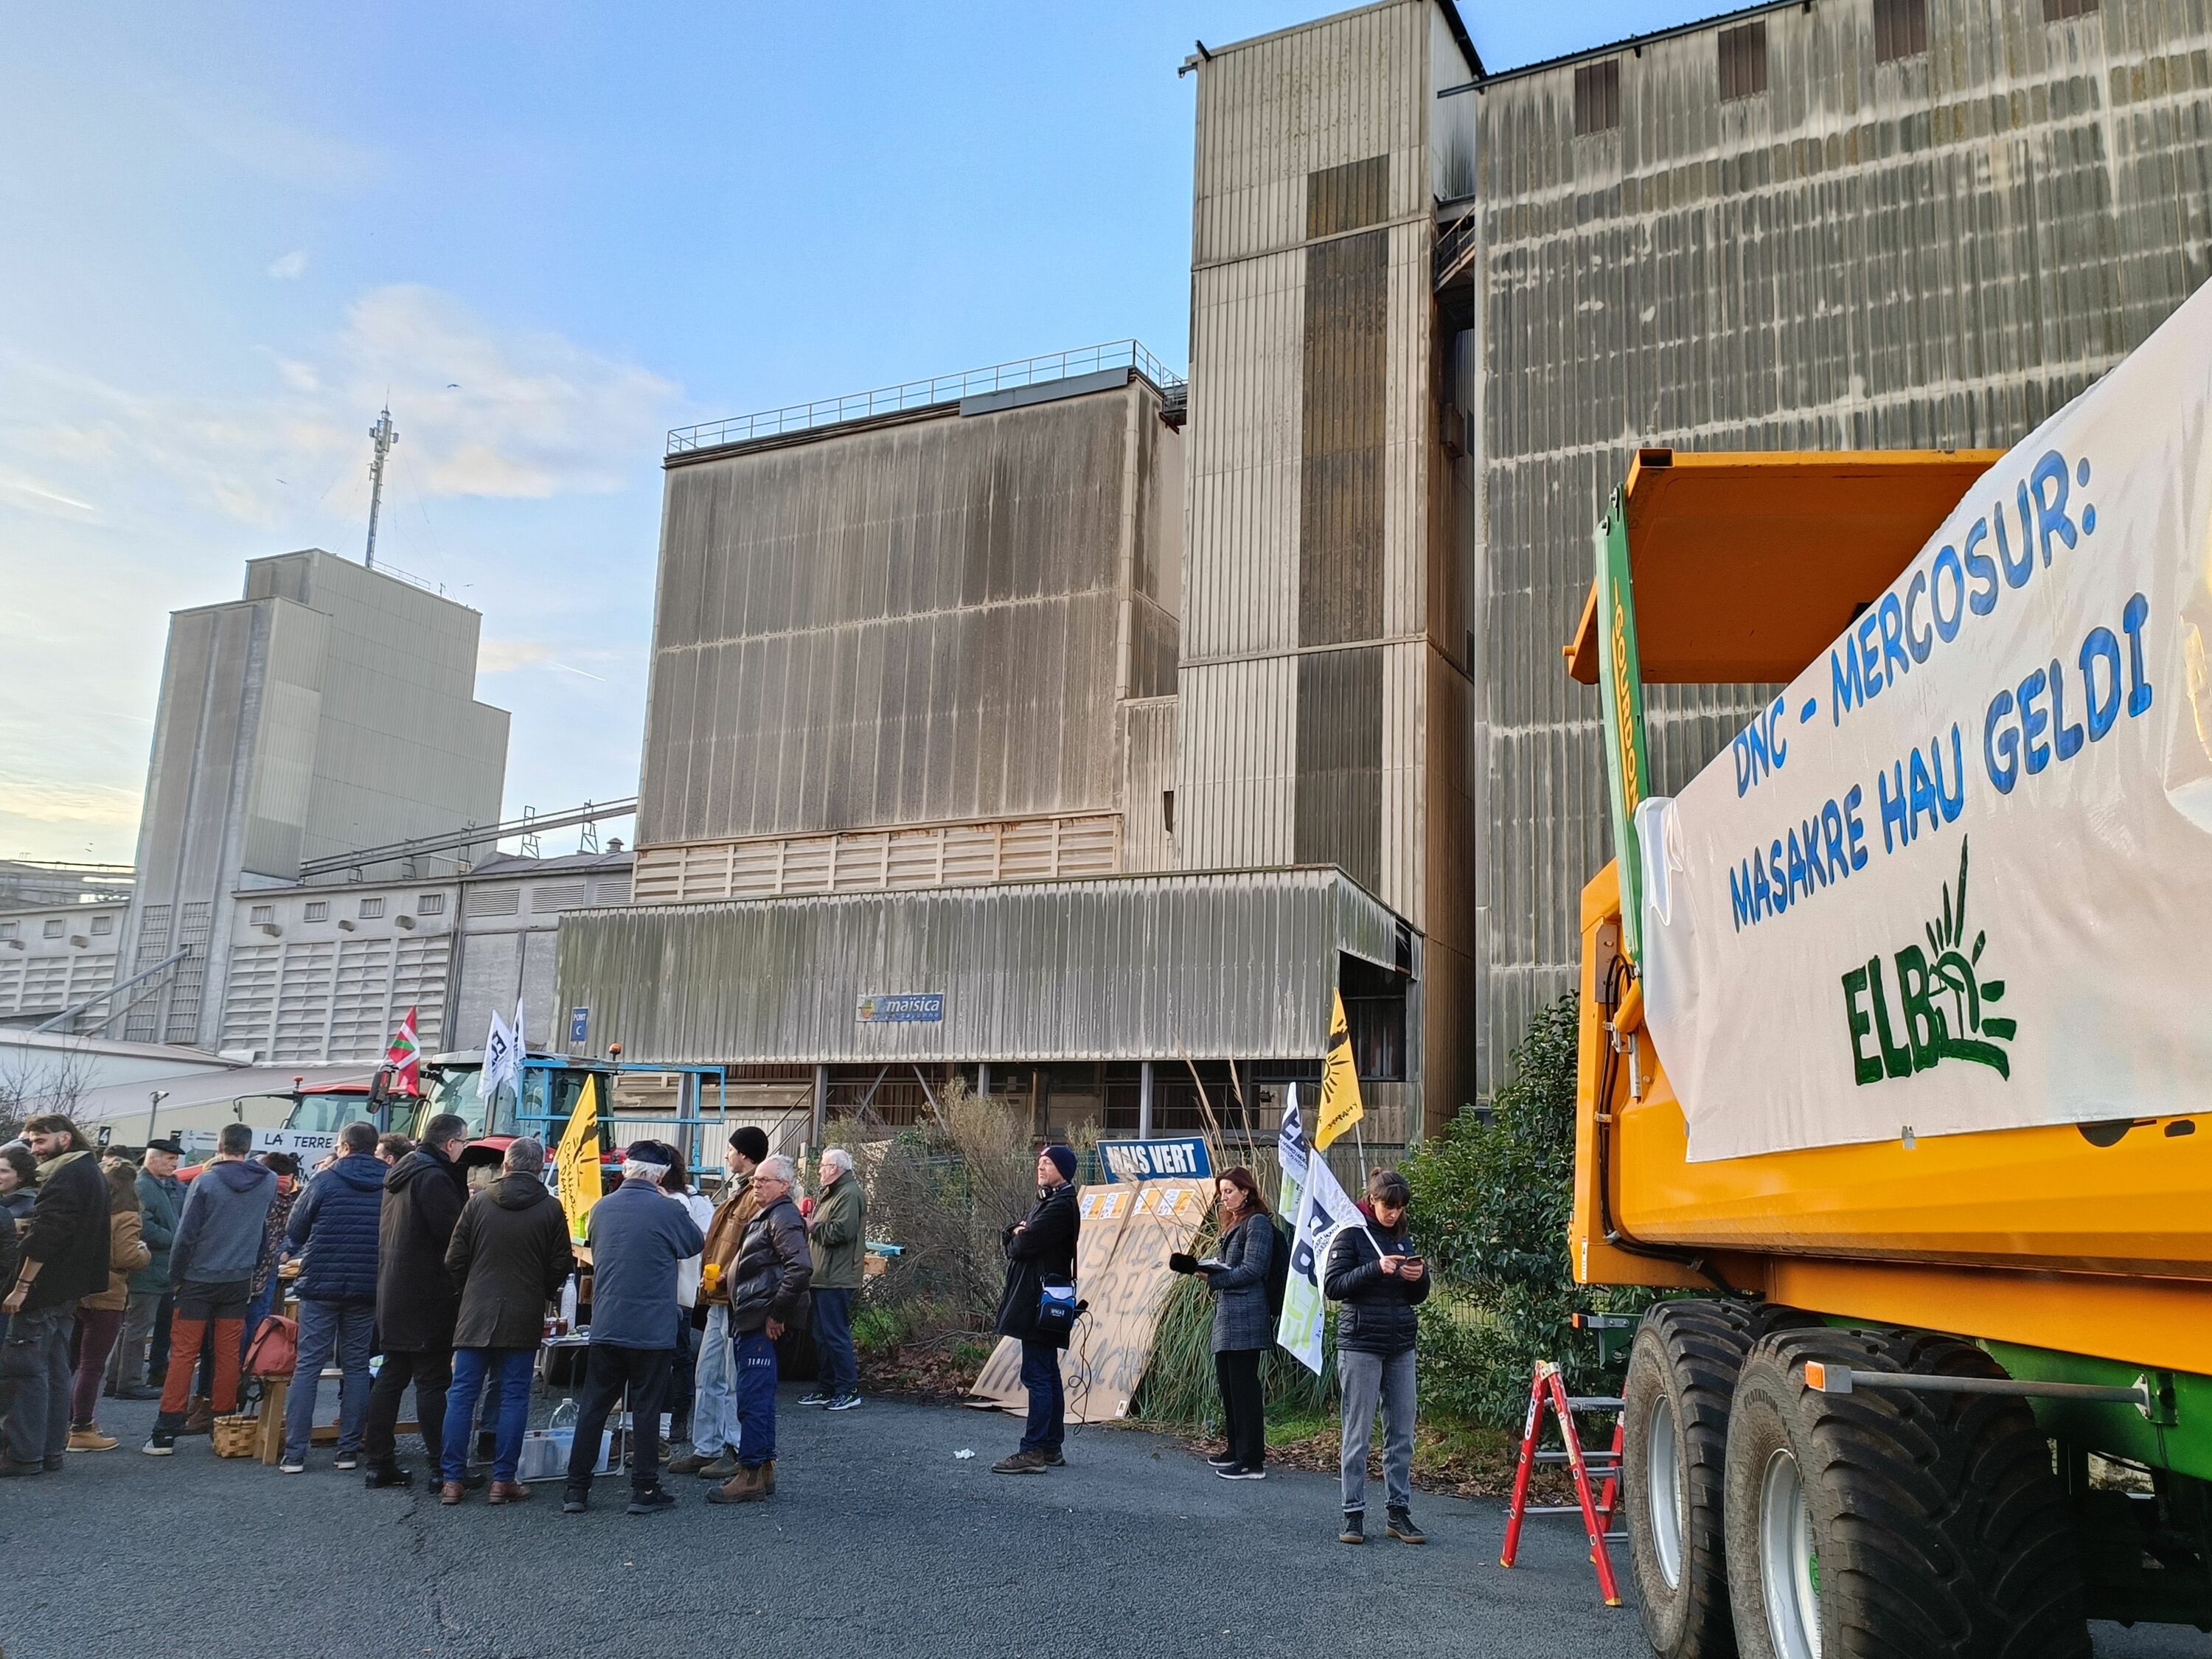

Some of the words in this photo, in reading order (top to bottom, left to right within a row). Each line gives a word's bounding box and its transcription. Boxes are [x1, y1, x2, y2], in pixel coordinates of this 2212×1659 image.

[1732, 695, 1788, 799] DNC
[1830, 448, 2096, 728] MERCOSUR:
[1613, 602, 1641, 813] GOURDON
[1728, 782, 1868, 933] MASAKRE
[1877, 723, 1966, 854] HAU
[1983, 591, 2154, 796] GELDI
[575, 1025, 582, 1036] C
[886, 996, 940, 1012] maïsica
[1840, 941, 1940, 1086] ELB
[265, 1133, 283, 1146] LA
[294, 1135, 333, 1149] TERRE
[1148, 1143, 1197, 1174] VERT
